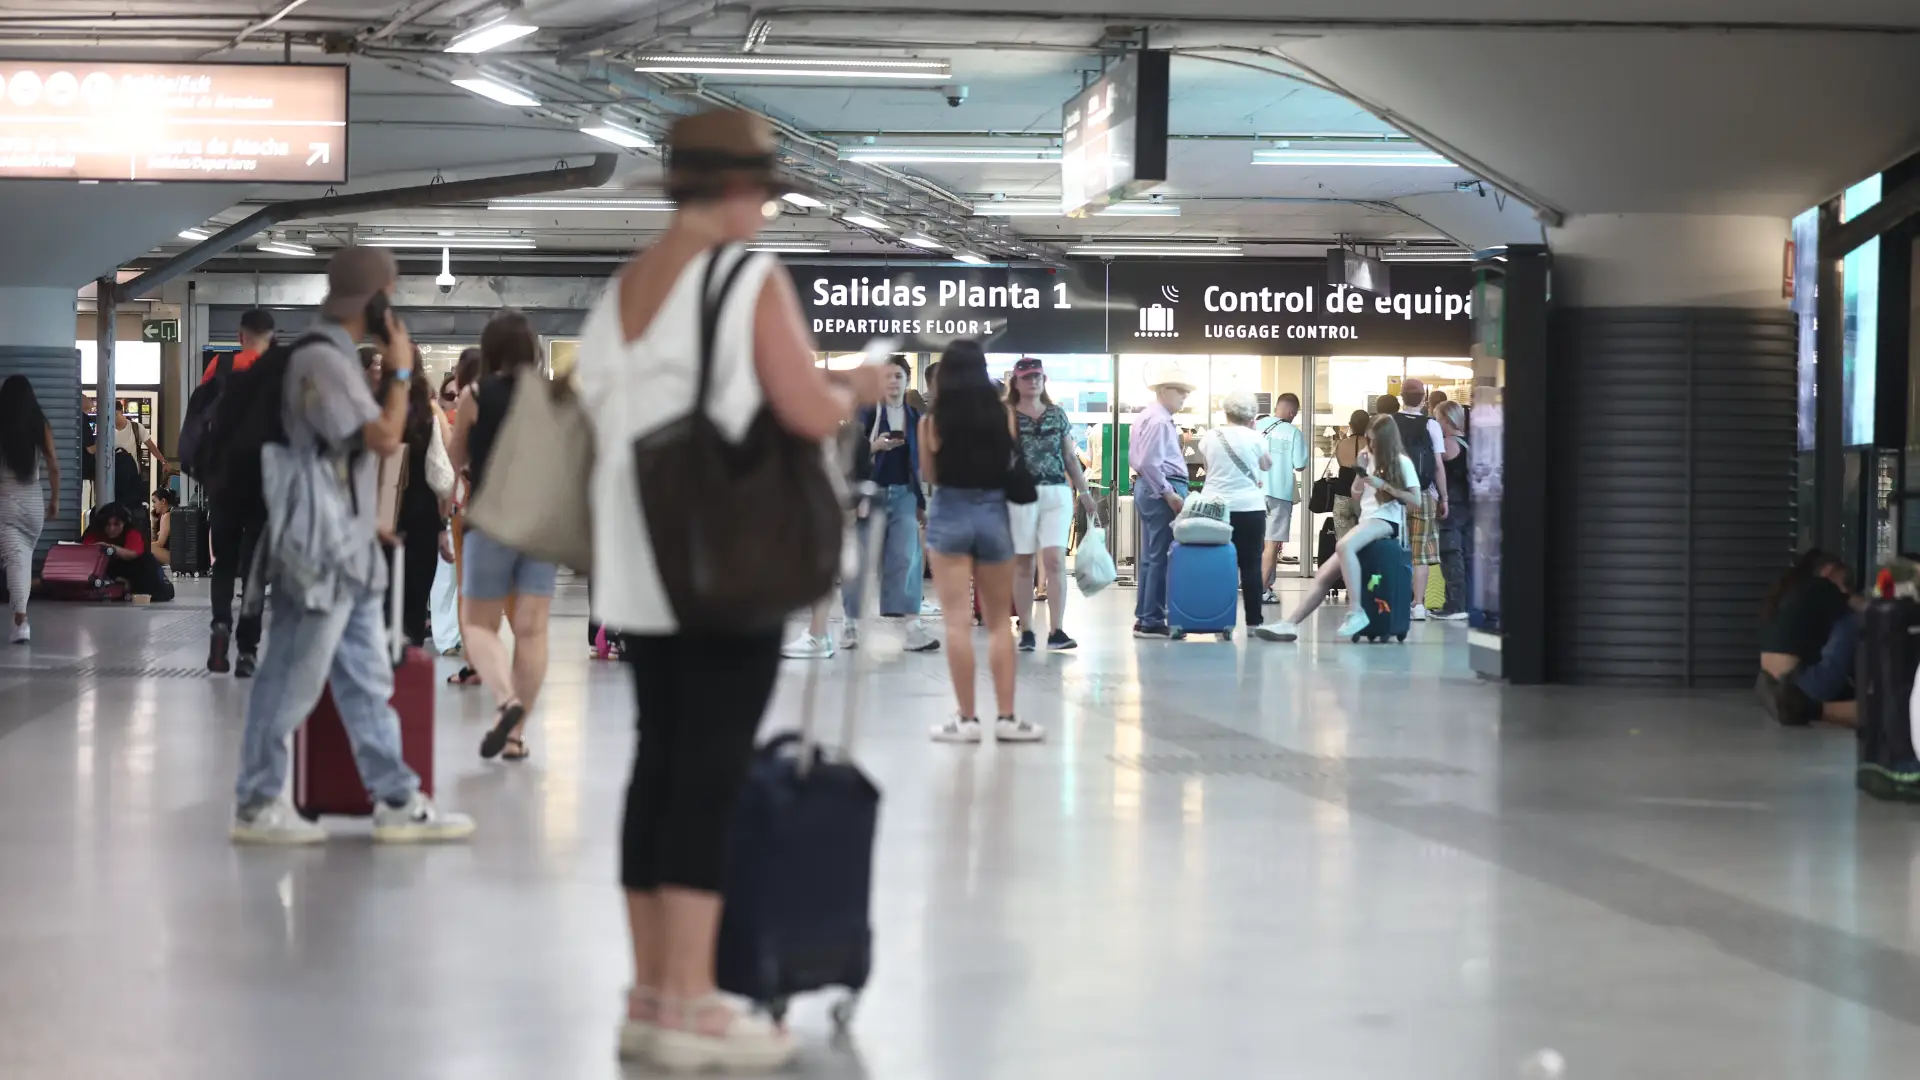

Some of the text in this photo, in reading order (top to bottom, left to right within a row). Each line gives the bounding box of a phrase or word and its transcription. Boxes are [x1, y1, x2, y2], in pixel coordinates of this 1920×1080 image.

[813, 277, 1072, 309] Salidas Planta 1
[1204, 285, 1313, 312] Control
[1326, 286, 1363, 313] de
[813, 318, 993, 335] DEPARTURES FLOOR 1
[1205, 325, 1359, 339] LUGGAGE CONTROL
